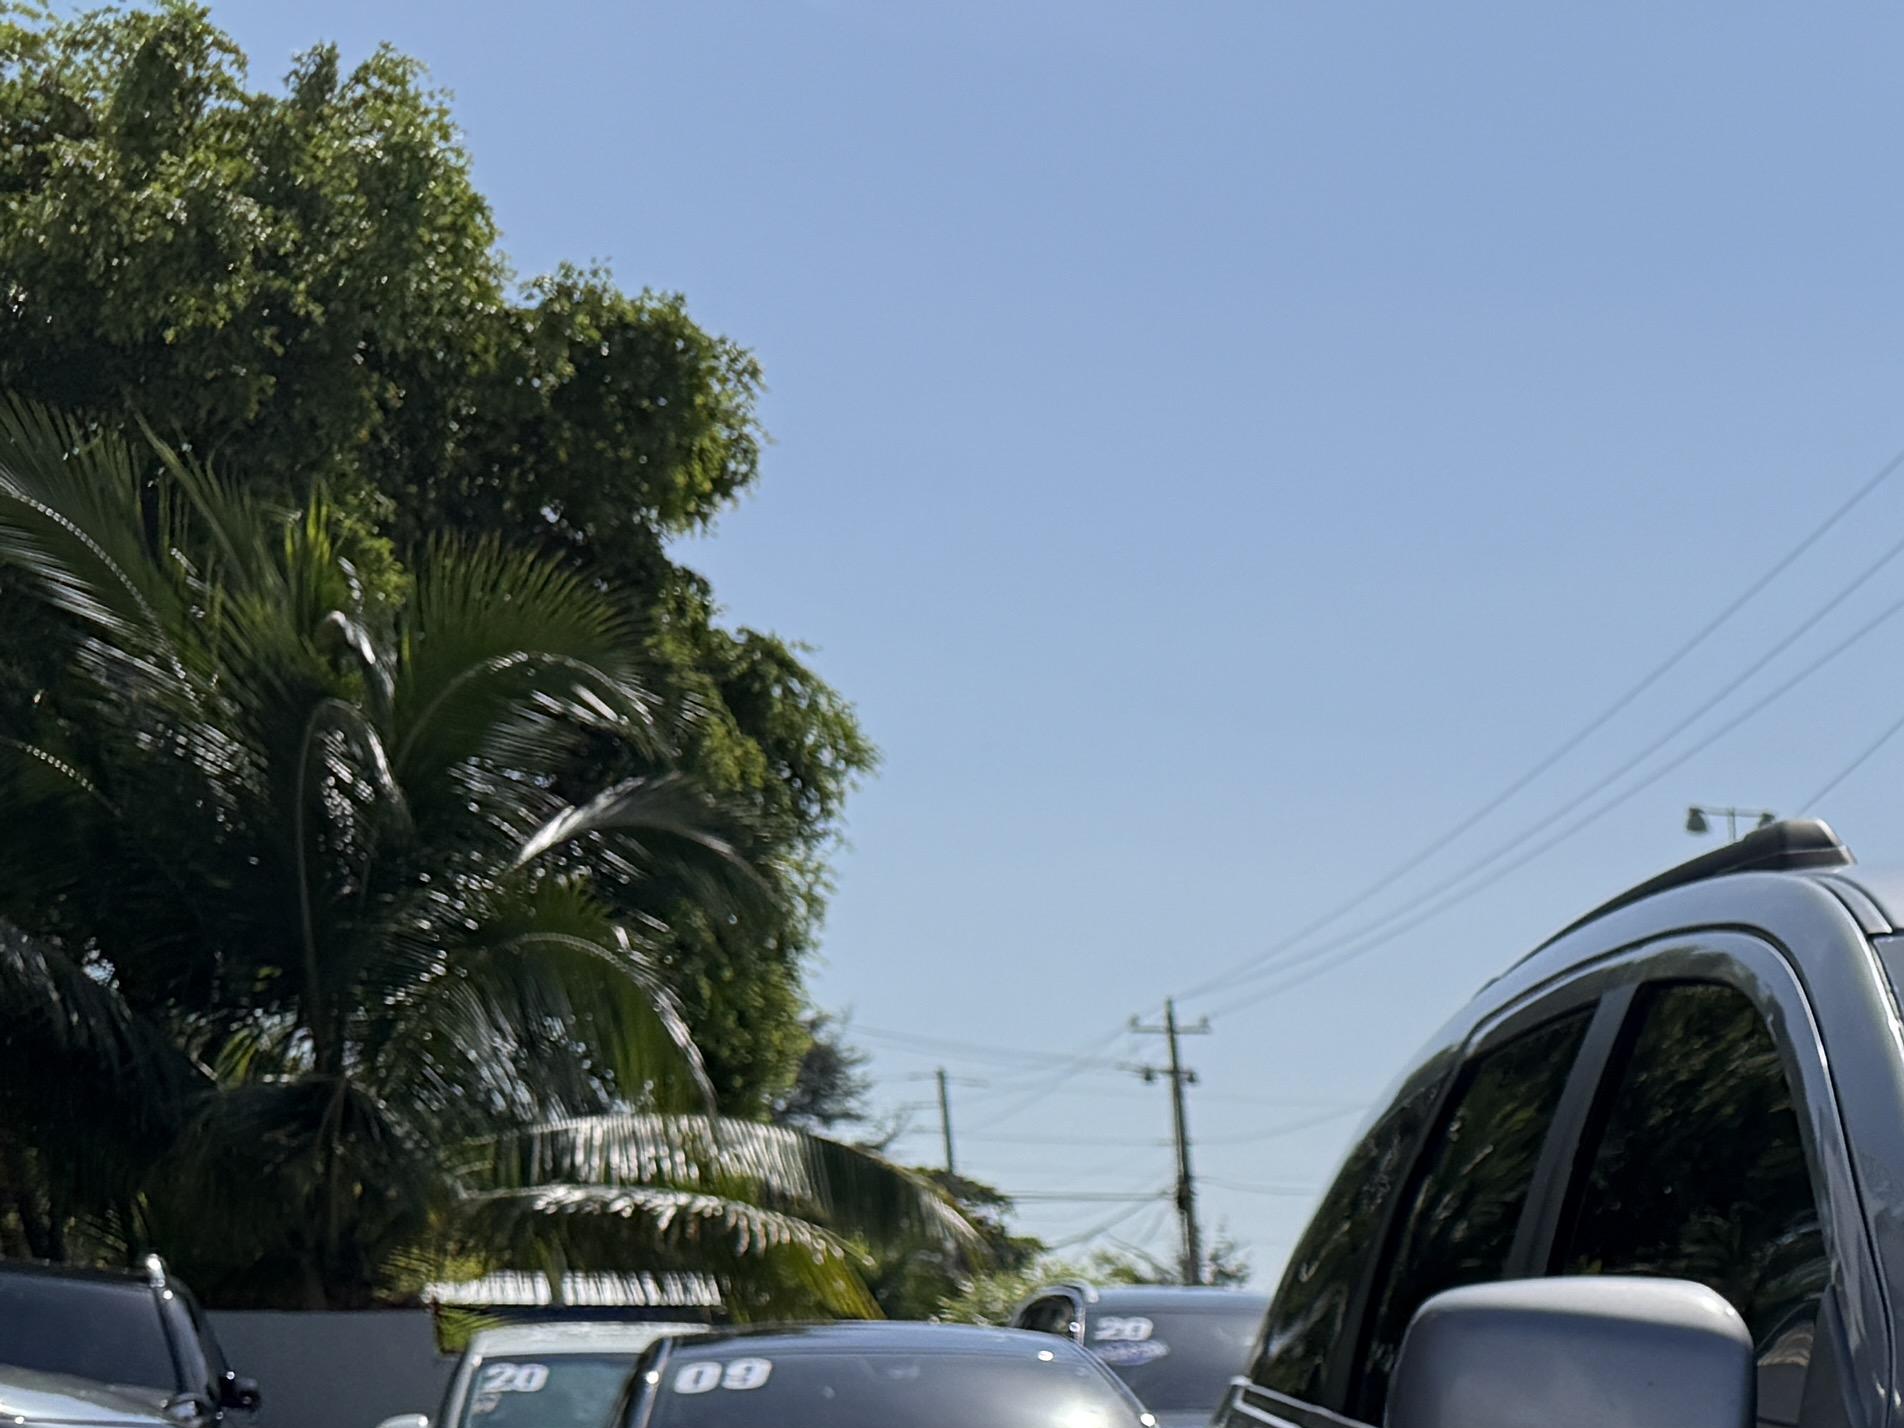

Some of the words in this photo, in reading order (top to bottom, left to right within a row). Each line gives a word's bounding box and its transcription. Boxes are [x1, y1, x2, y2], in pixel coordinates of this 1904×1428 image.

[1094, 1316, 1153, 1341] 20
[483, 1362, 549, 1393] 20
[674, 1357, 772, 1394] 09
